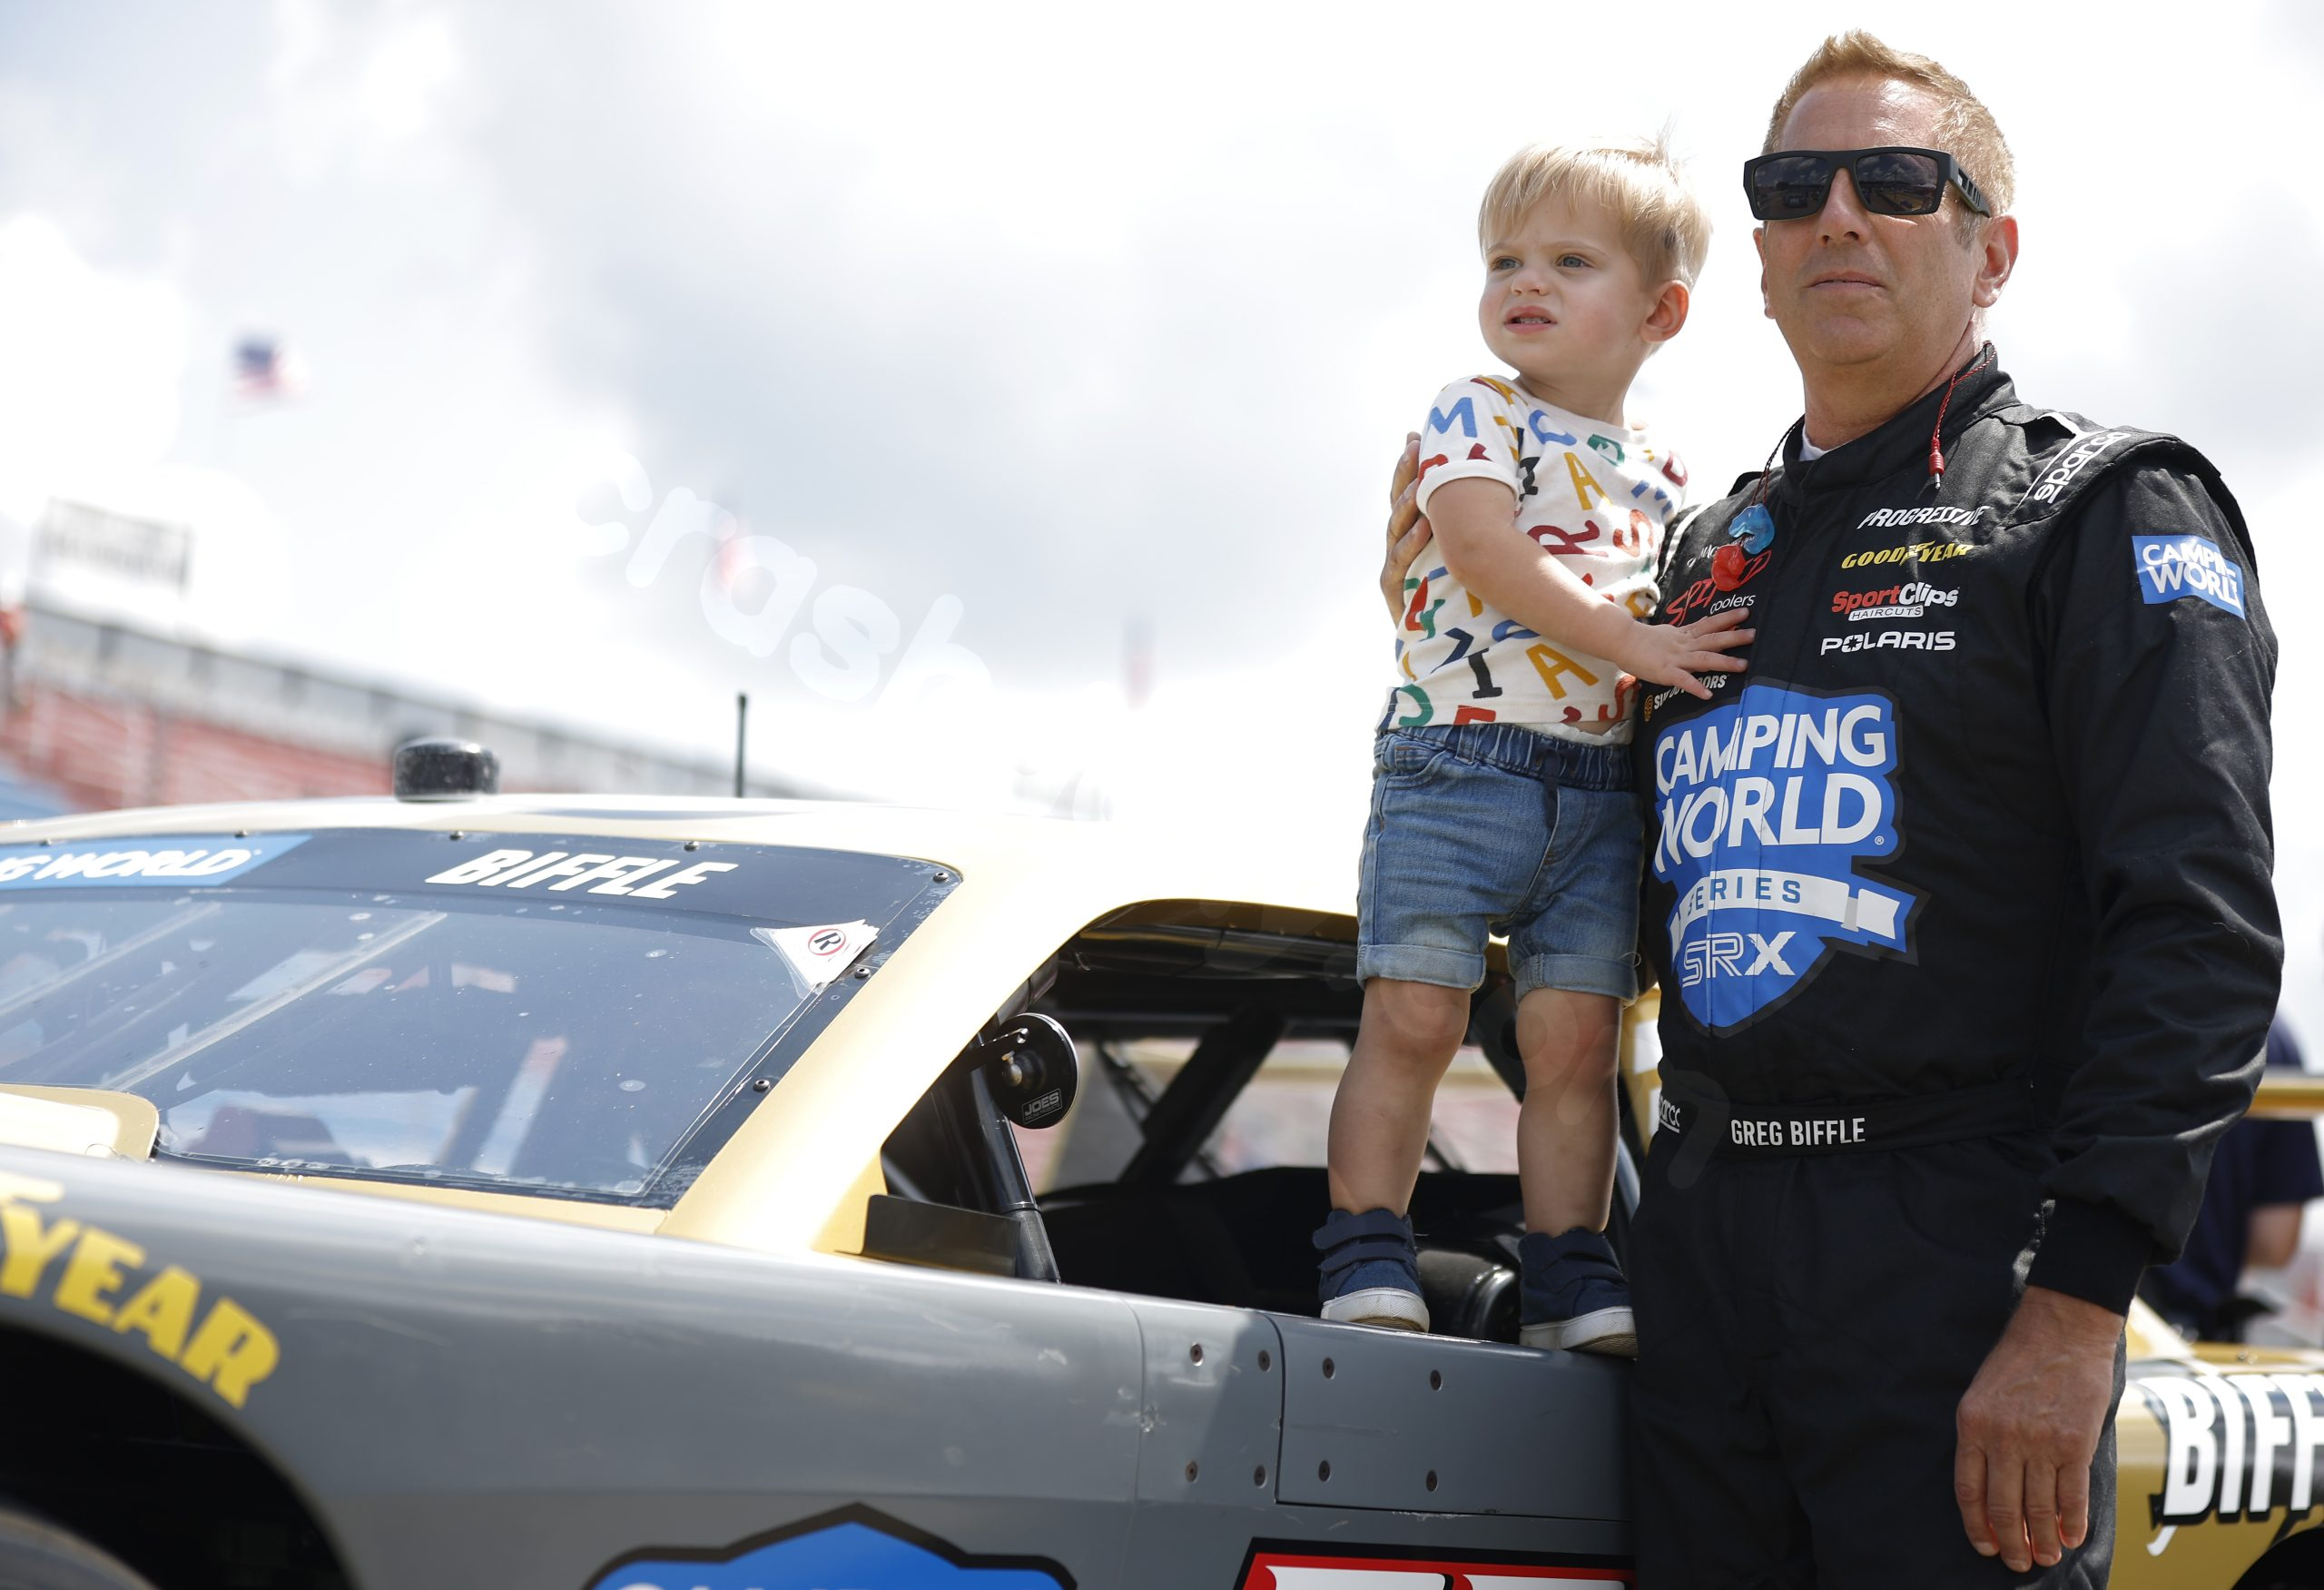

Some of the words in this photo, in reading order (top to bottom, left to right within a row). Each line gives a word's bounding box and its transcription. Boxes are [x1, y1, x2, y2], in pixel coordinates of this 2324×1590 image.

[1856, 506, 1991, 530] PROGRESSIVE
[1841, 540, 1974, 569] GOODYEAR
[1709, 594, 1757, 615] coolers
[1851, 607, 1923, 620] HAIRCUTS
[1820, 631, 1956, 657] POLARIS
[1656, 705, 1886, 795] CAMPING
[1654, 772, 1884, 874] WORLD
[33, 849, 253, 881] WORLD
[424, 849, 740, 900] BIFFLE
[1682, 931, 1797, 988] SRX
[1024, 1091, 1060, 1116] JOES
[1730, 1118, 1783, 1147] GREG
[1789, 1117, 1866, 1147] BIFFLE
